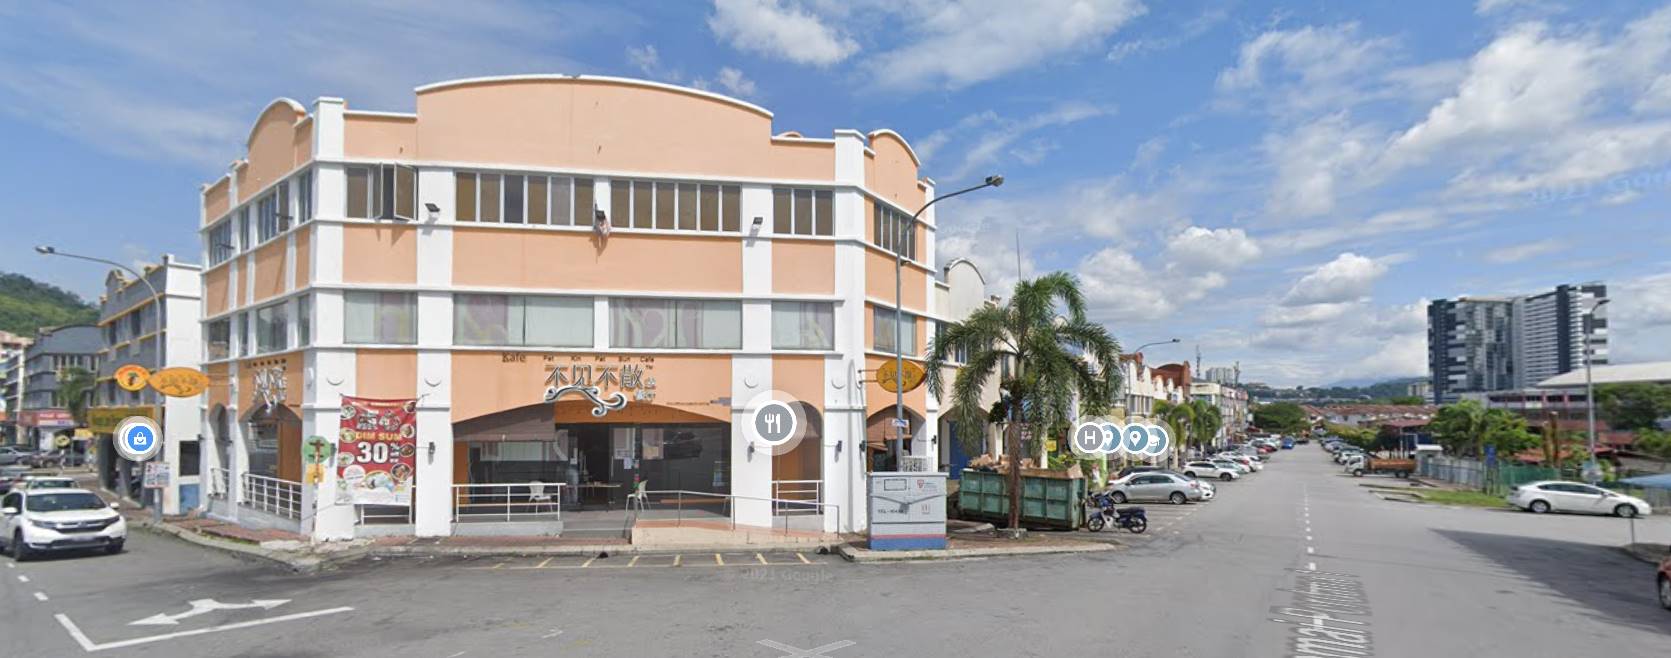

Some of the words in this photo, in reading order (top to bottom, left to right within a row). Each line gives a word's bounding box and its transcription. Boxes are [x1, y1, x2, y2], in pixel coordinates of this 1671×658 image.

[502, 352, 526, 362] Kafe
[544, 364, 643, 390] 不见不散
[355, 431, 376, 441] DIM
[356, 441, 388, 464] 30
